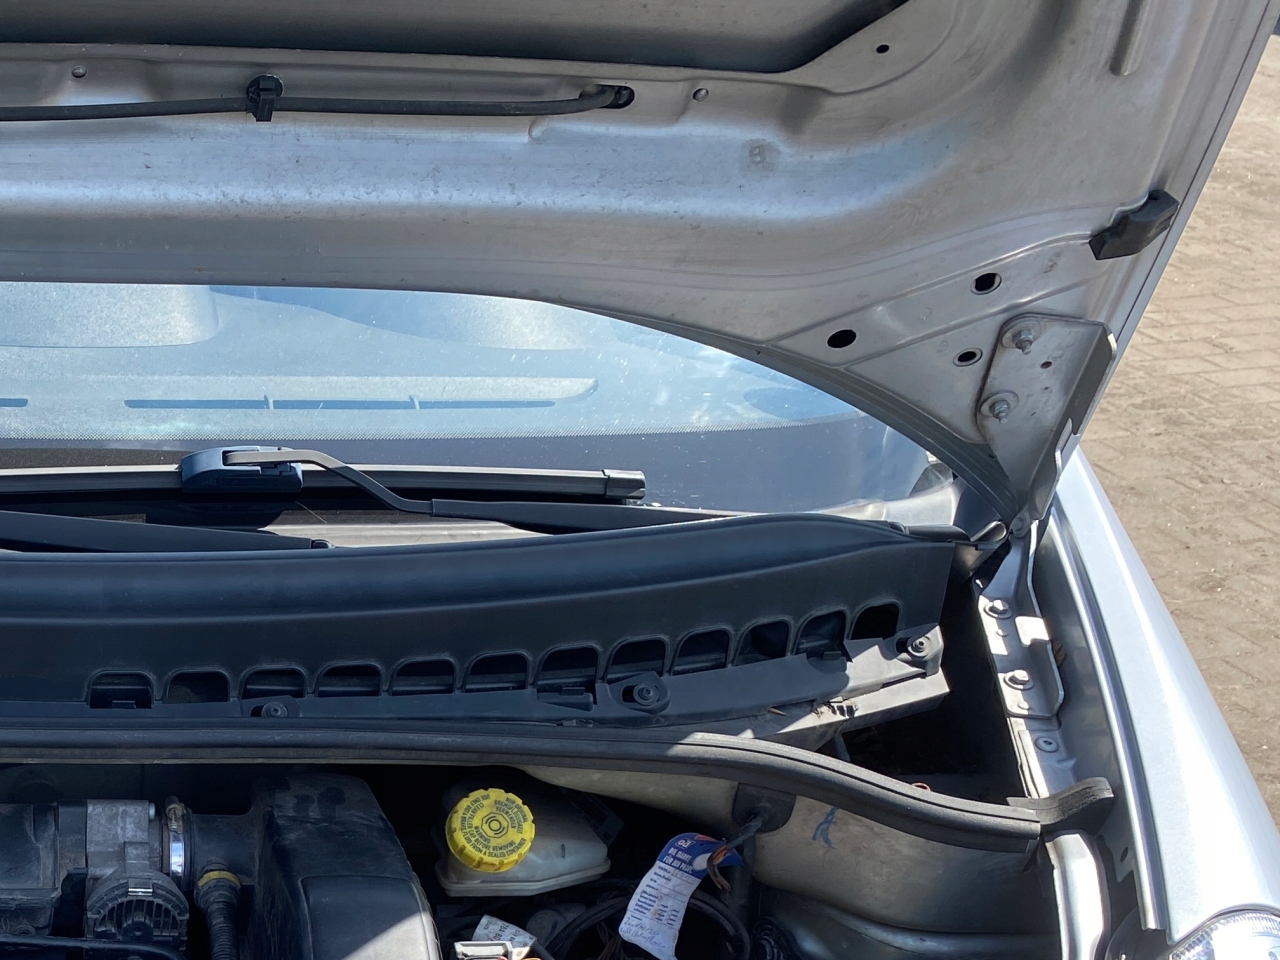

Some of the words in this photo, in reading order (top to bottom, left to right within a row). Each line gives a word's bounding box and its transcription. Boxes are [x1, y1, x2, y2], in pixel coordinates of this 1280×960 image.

[468, 829, 477, 839] CAP
[473, 837, 491, 851] BEFORE
[470, 842, 483, 854] FROM
[505, 837, 527, 856] CONTAINER
